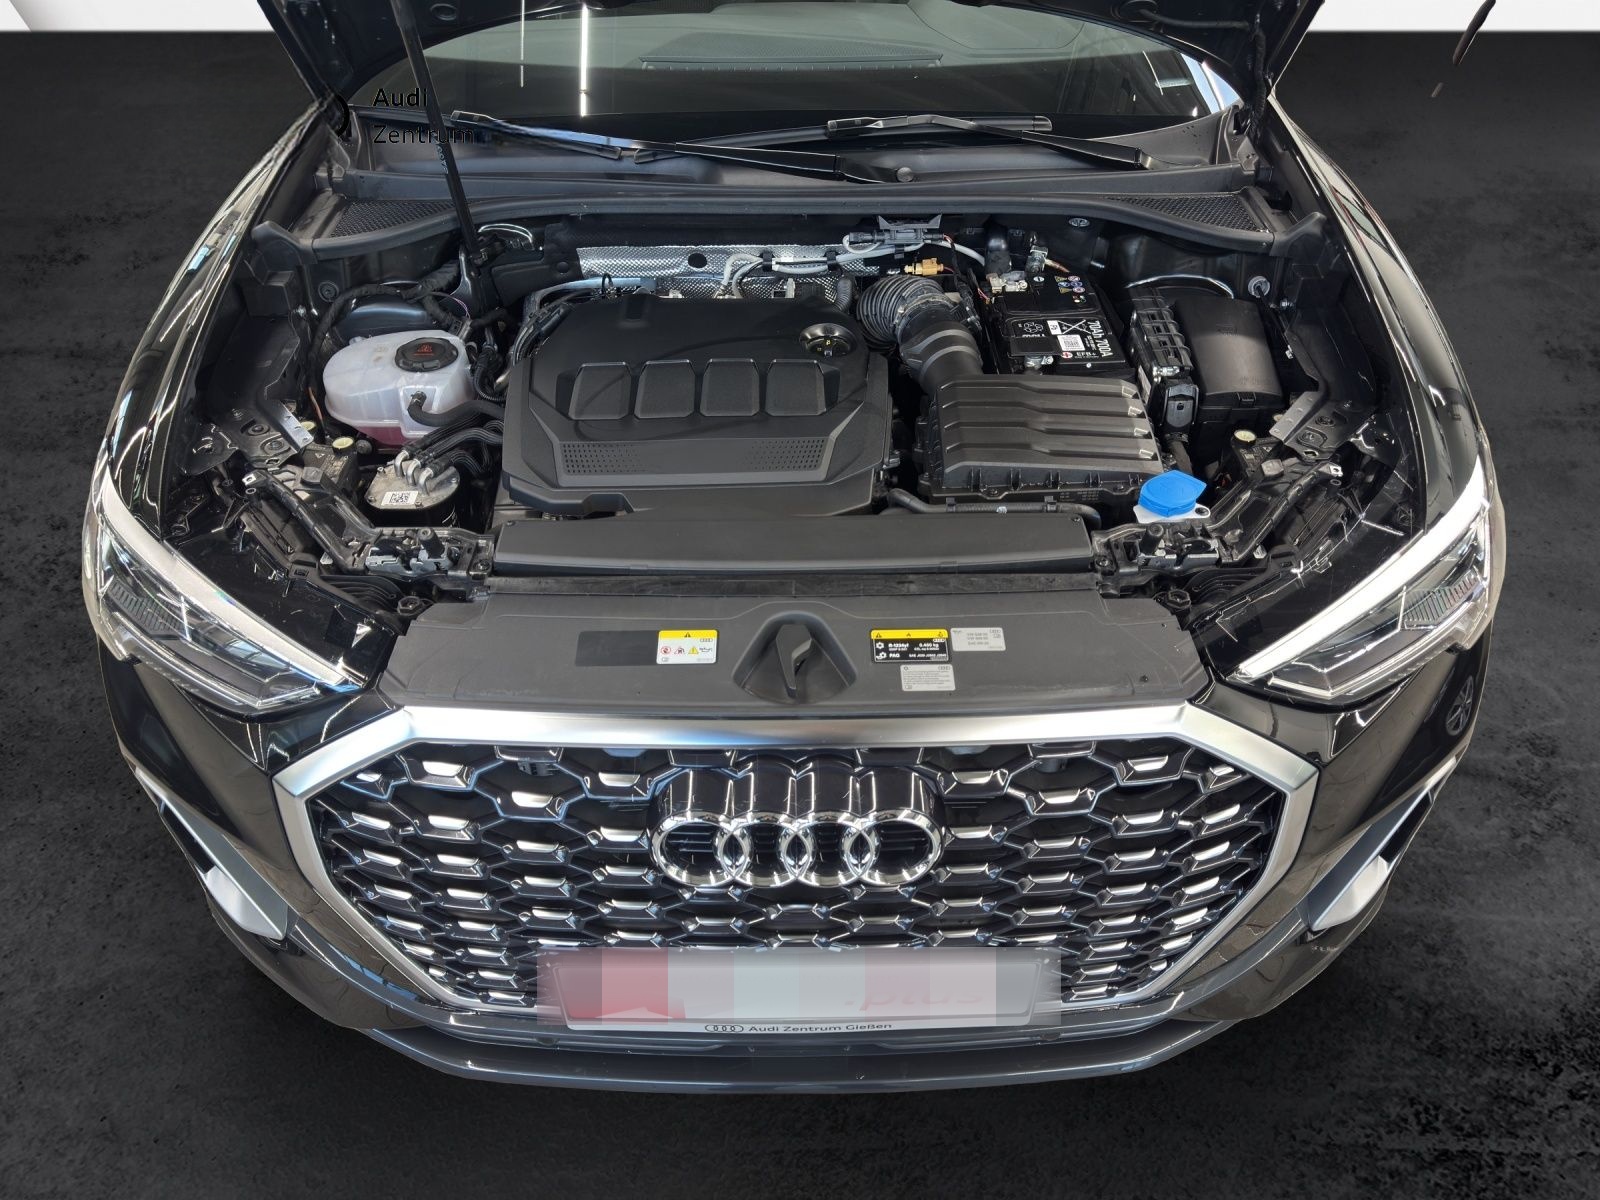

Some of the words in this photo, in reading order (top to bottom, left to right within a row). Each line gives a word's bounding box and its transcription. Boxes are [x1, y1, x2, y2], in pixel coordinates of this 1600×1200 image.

[1087, 320, 1104, 338] 70Ah
[1095, 339, 1113, 357] 700A
[748, 1024, 780, 1033] Audi
[783, 1023, 842, 1032] Zentrum
[845, 1022, 893, 1031] Gießen
